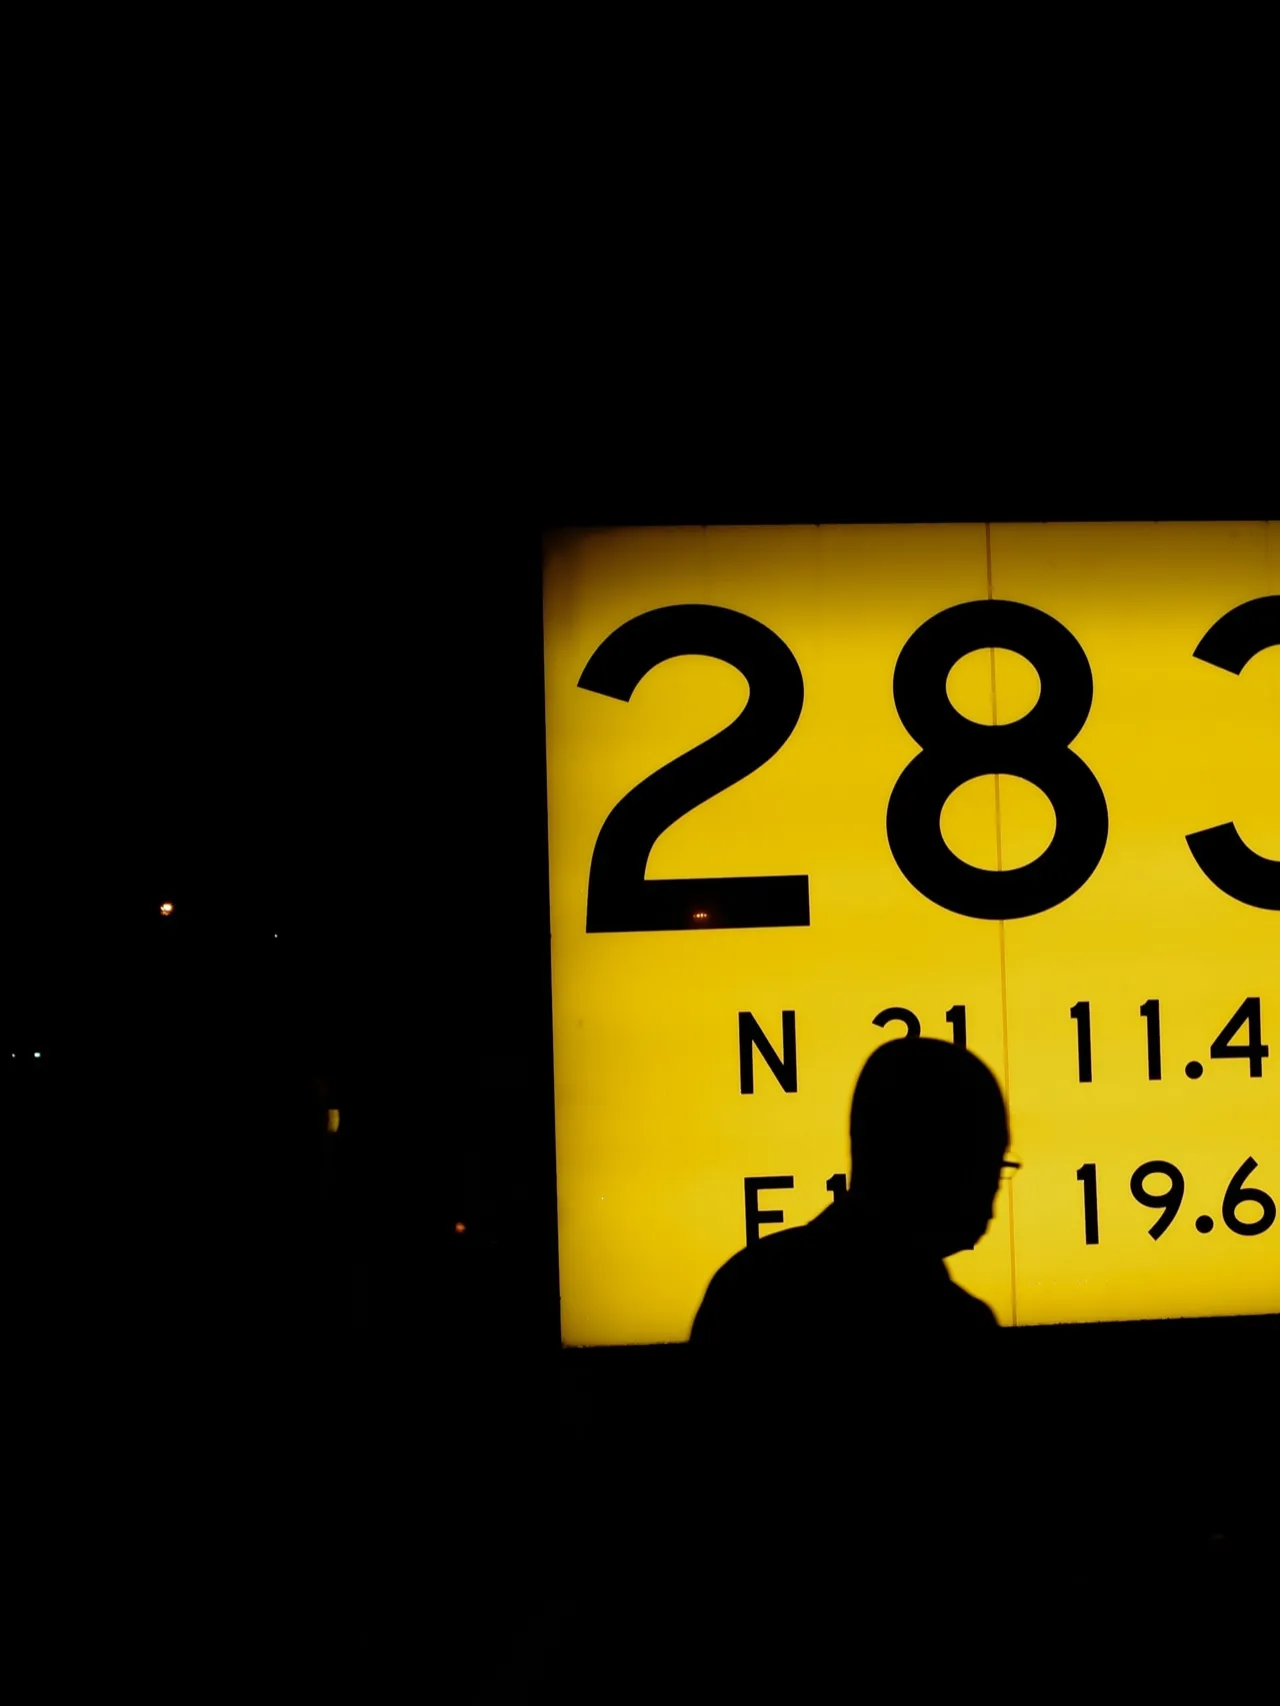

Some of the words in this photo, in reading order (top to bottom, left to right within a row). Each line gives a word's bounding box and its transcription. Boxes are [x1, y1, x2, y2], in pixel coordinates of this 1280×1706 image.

[739, 1010, 798, 1095] N
[1070, 996, 1269, 1083] 11.4
[1076, 1157, 1278, 1245] 19.6
